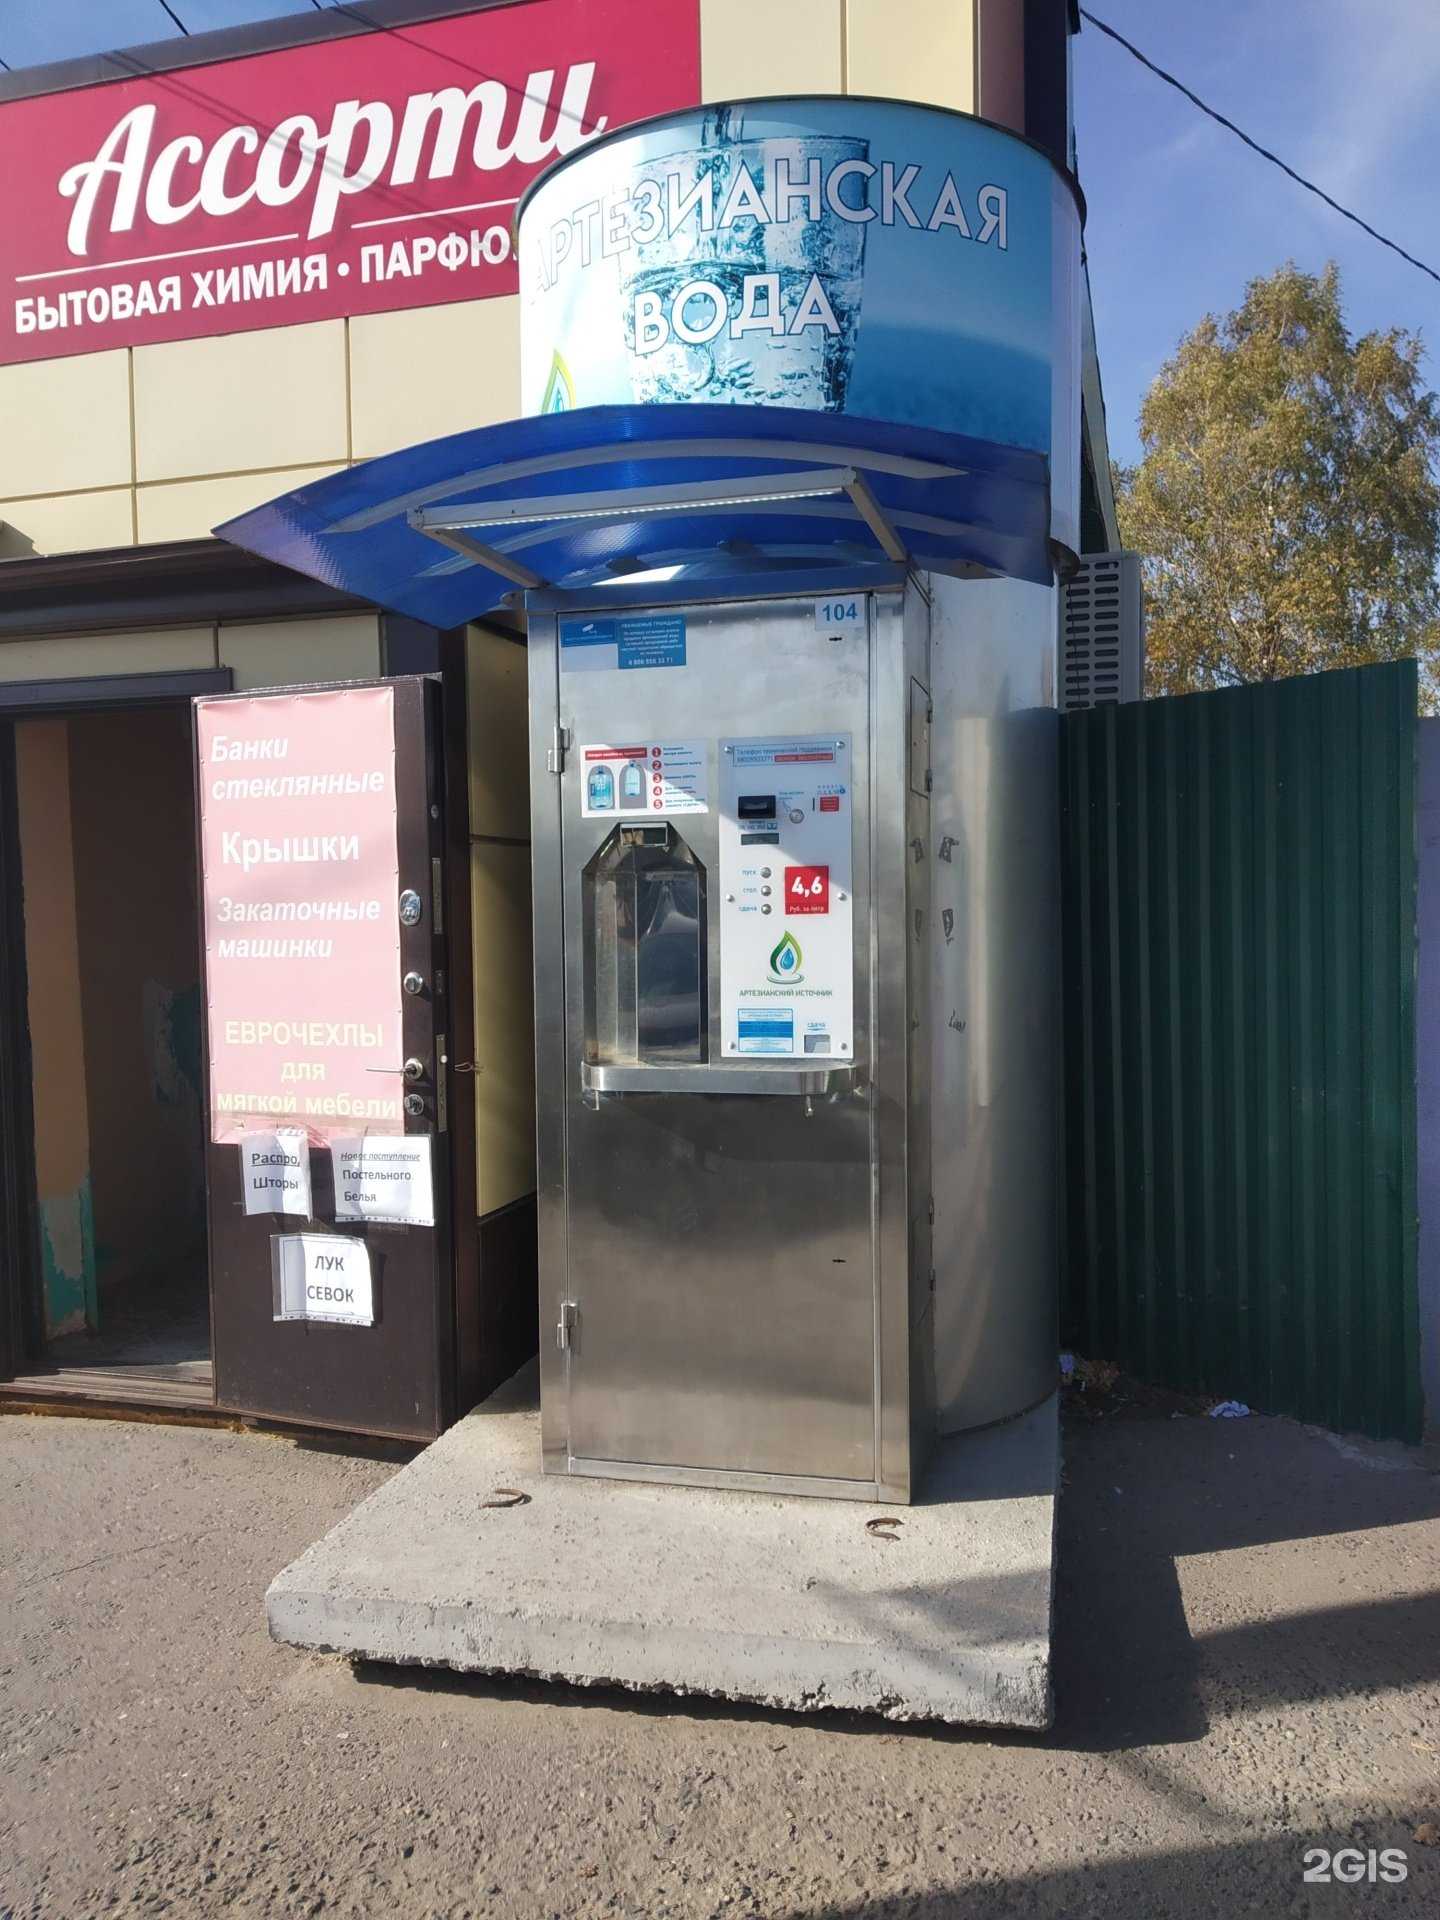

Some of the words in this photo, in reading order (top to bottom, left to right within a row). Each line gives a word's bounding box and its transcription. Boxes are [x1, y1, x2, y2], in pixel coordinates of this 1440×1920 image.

[58, 61, 608, 256] Ассорти
[531, 158, 1009, 303] АРТЕЗИАНСКАЯ
[15, 277, 183, 335] БЫТОВАЯ
[191, 253, 329, 310] ХИМИЯ
[360, 225, 519, 284] ПАРФЮ
[634, 273, 842, 357] ВОДА
[822, 602, 858, 621] 104
[211, 735, 289, 762] Банки
[212, 770, 385, 800] стеклянные
[222, 831, 360, 872] Крышки
[791, 876, 823, 898] 4,6
[217, 897, 381, 923] Закаточные
[218, 938, 333, 959] машинки
[739, 988, 795, 997] АРТЕЗИАНСКИЙ
[224, 1020, 384, 1048] ЕВРОЧЕХЛЫ
[281, 1062, 326, 1082] для
[217, 1091, 297, 1113] мягкой
[306, 1093, 397, 1119] мебели
[251, 1153, 300, 1166] Распро
[253, 1176, 298, 1191] Шторы
[342, 1169, 411, 1180] Постельного
[344, 1191, 377, 1202] Белья
[314, 1255, 345, 1271] ЛУК
[306, 1285, 354, 1303] СЕВОК
